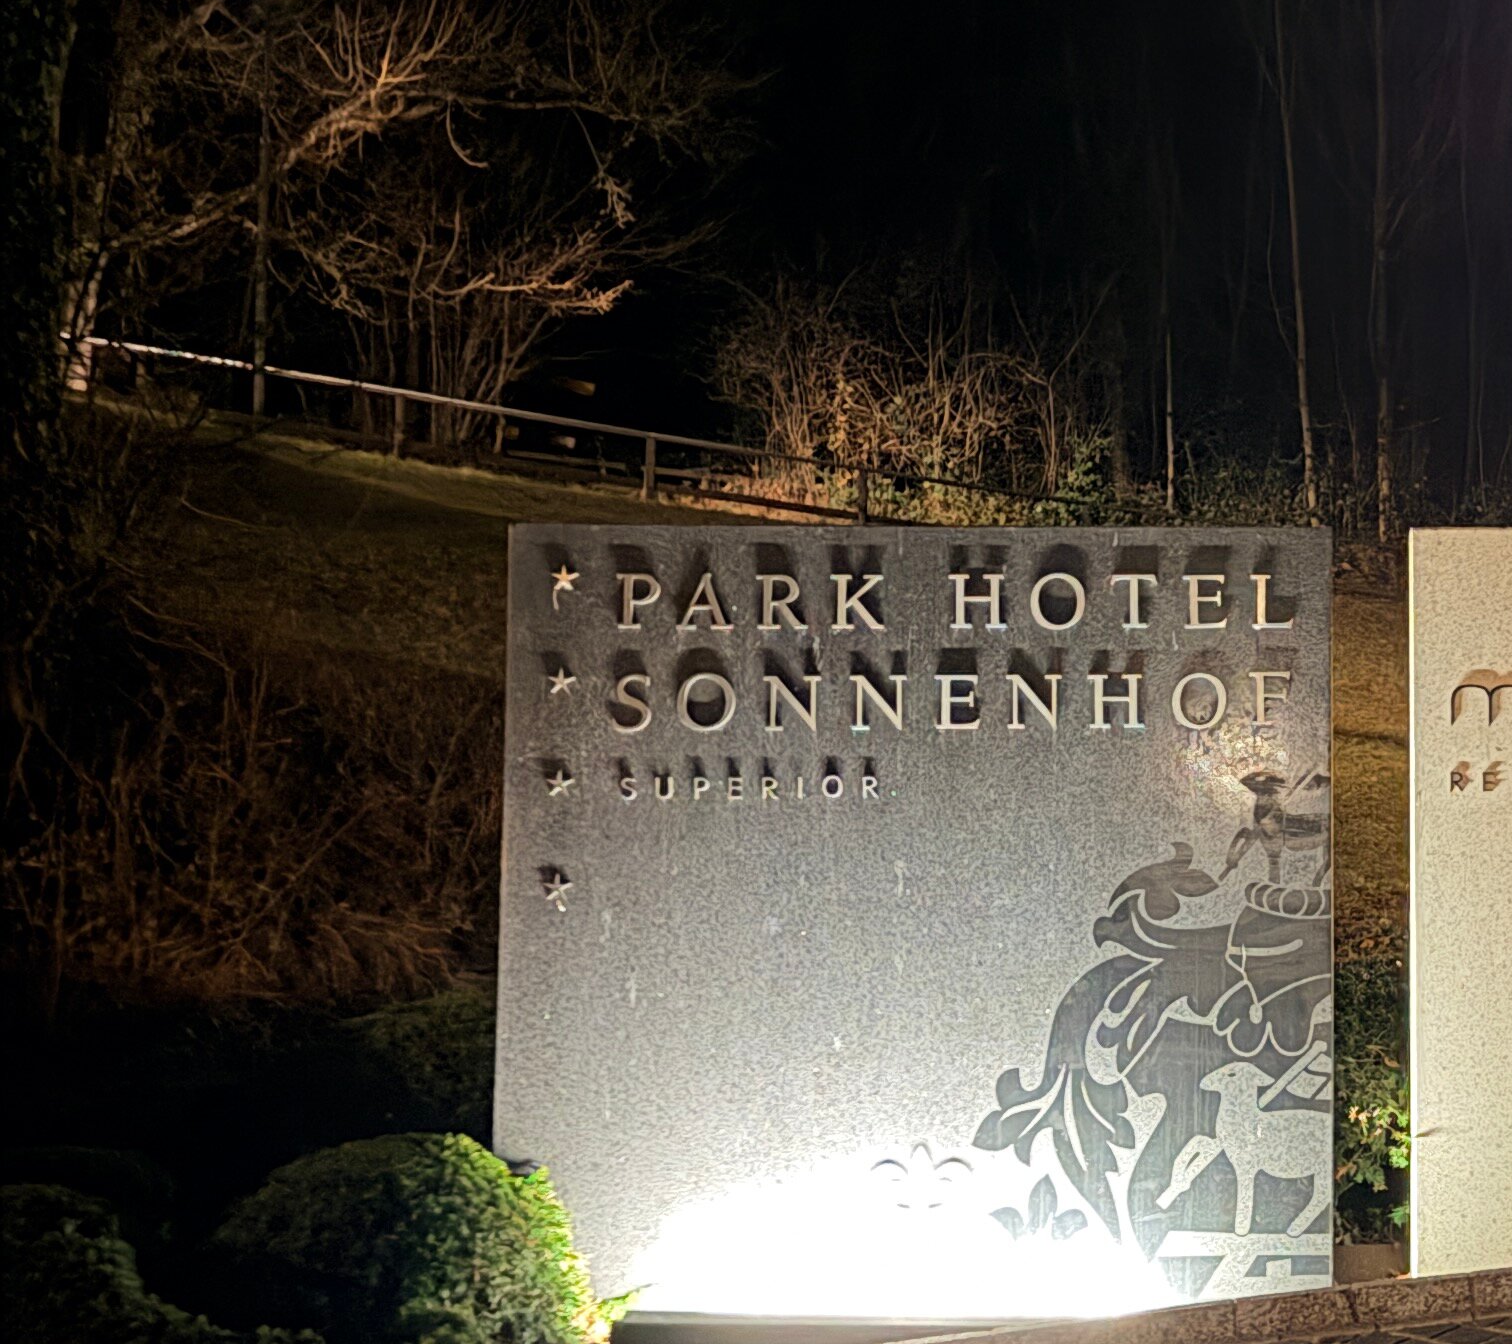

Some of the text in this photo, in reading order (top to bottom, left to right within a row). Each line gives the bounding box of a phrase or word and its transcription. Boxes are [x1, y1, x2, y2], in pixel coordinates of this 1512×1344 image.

[615, 572, 1294, 630] PARK HOTEL
[612, 672, 1292, 732] SONNENHOF
[620, 775, 880, 801] SUPERIOR
